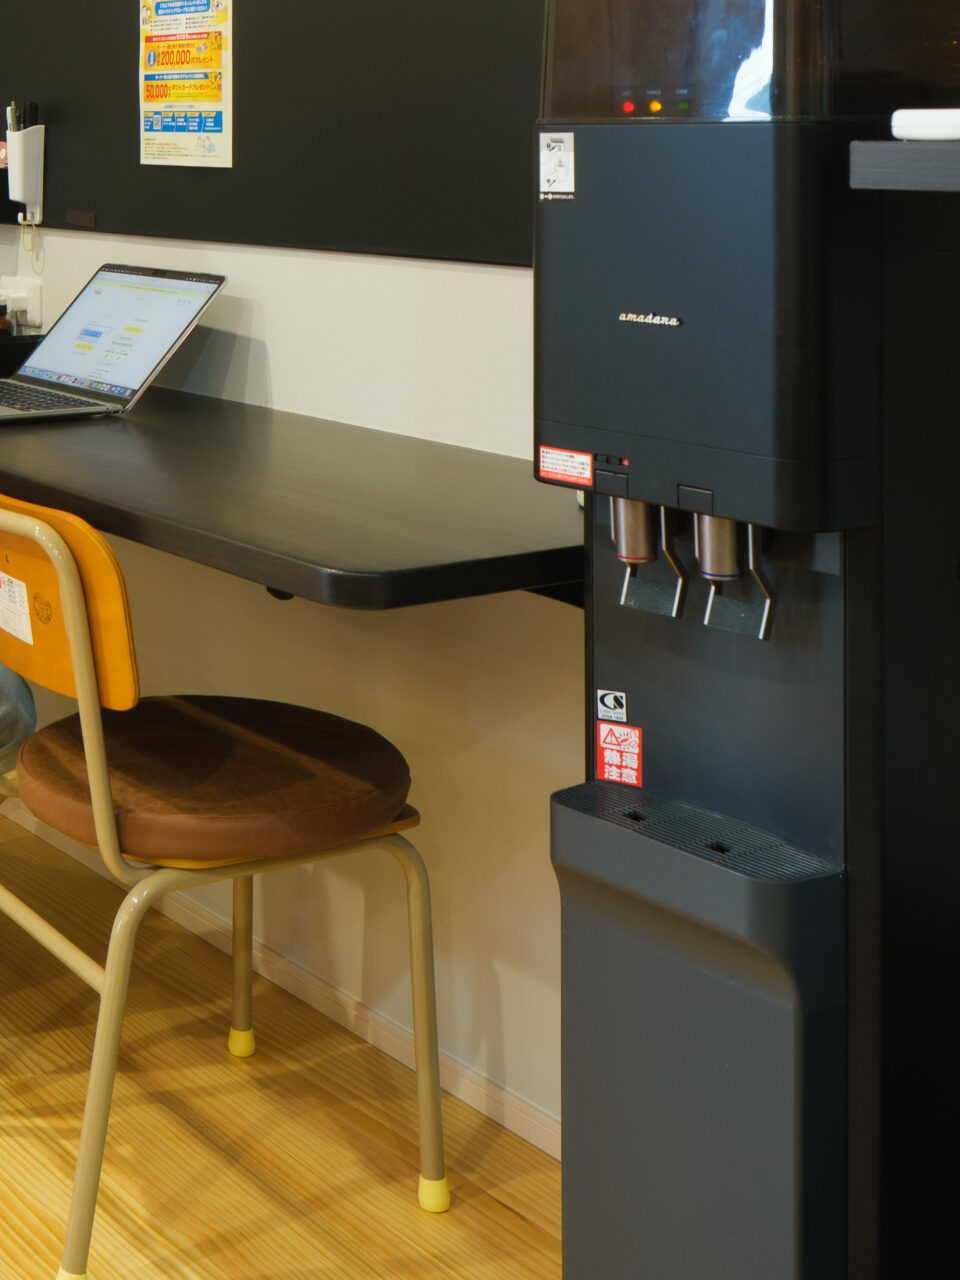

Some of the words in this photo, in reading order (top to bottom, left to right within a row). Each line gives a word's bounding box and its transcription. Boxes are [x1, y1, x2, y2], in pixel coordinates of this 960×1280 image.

[160, 48, 190, 66] 200,000
[145, 83, 168, 98] 50,000
[619, 312, 680, 326] amadana
[603, 748, 639, 769] 熱湯
[603, 764, 638, 784] 注意
